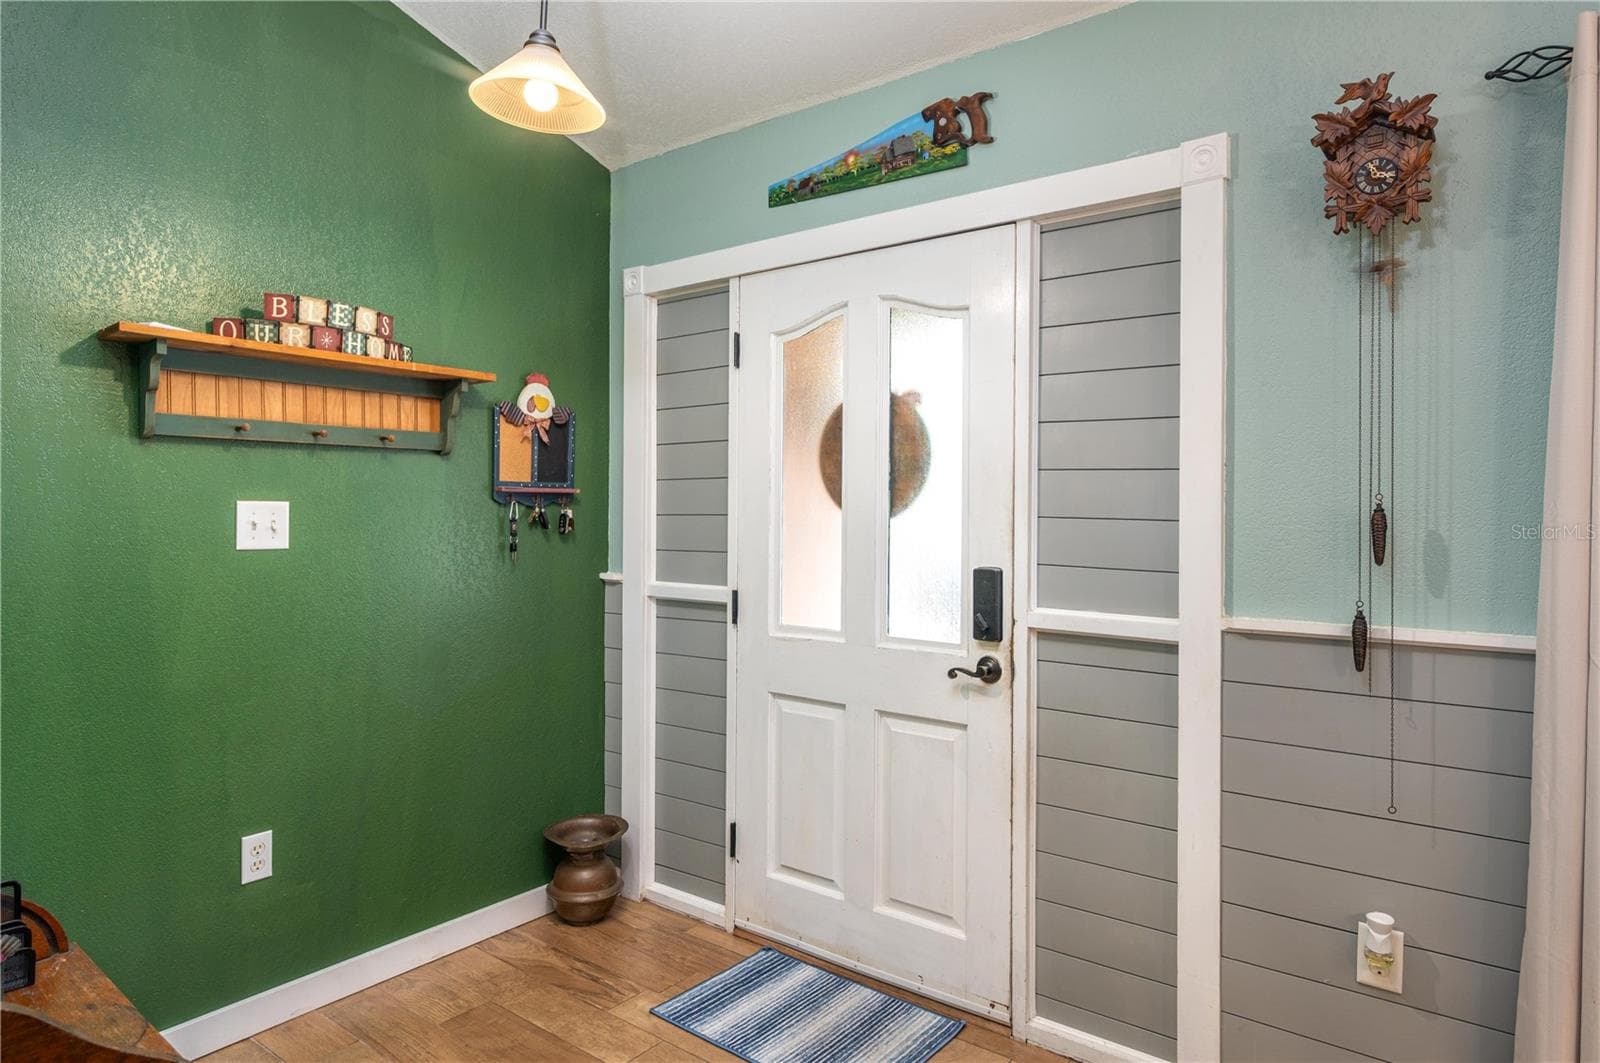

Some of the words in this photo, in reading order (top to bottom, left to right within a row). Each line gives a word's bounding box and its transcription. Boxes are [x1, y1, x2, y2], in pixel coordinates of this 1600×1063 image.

[271, 296, 389, 336] BLESS
[219, 319, 305, 348] OUR
[347, 331, 412, 363] HOME
